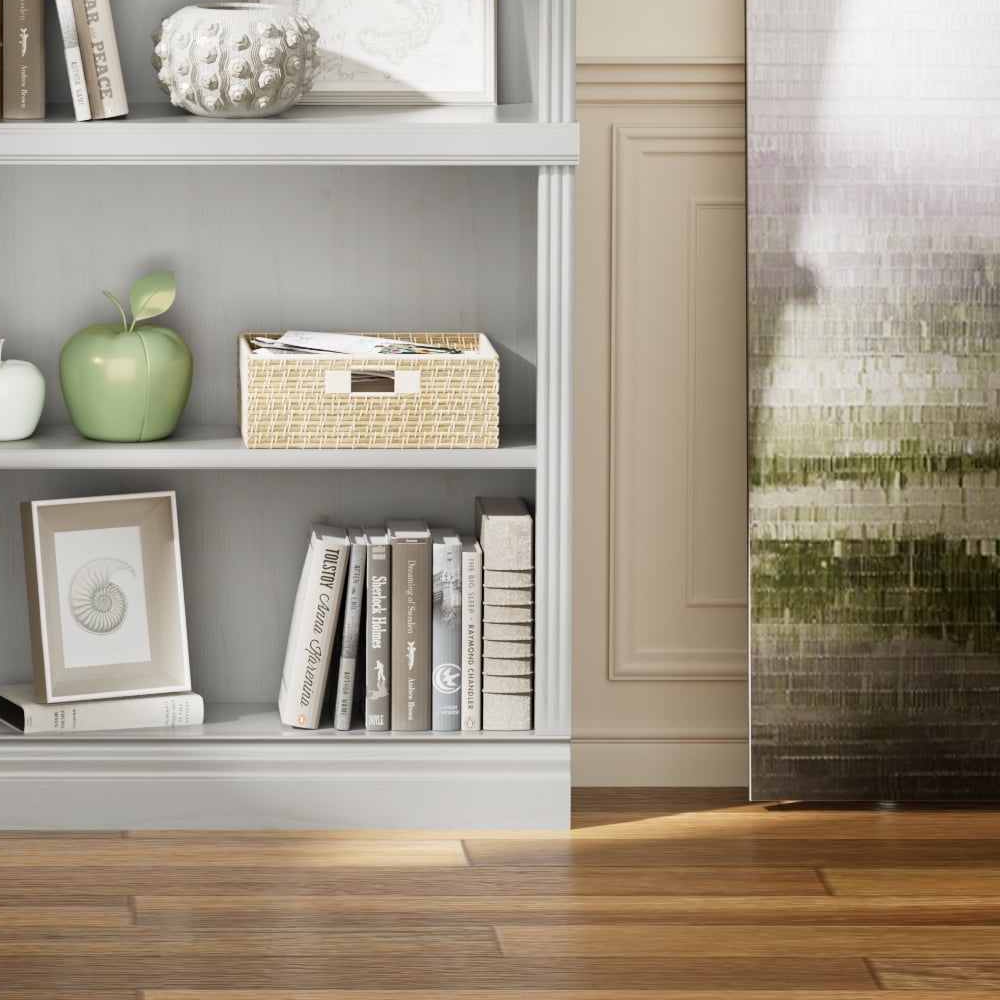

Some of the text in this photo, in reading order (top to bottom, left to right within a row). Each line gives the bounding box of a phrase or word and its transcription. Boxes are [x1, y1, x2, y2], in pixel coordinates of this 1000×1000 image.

[91, 41, 114, 100] PEACE
[372, 575, 387, 616] Sherlock
[406, 560, 416, 596] Dreaming
[300, 548, 340, 708] TOLSTOY Anna Karenina
[372, 617, 387, 649] Holmes
[407, 606, 416, 634] Sweden
[467, 624, 475, 666] RAYMOND
[467, 668, 475, 710] CHANDLER
[368, 714, 384, 726] DOYLE
